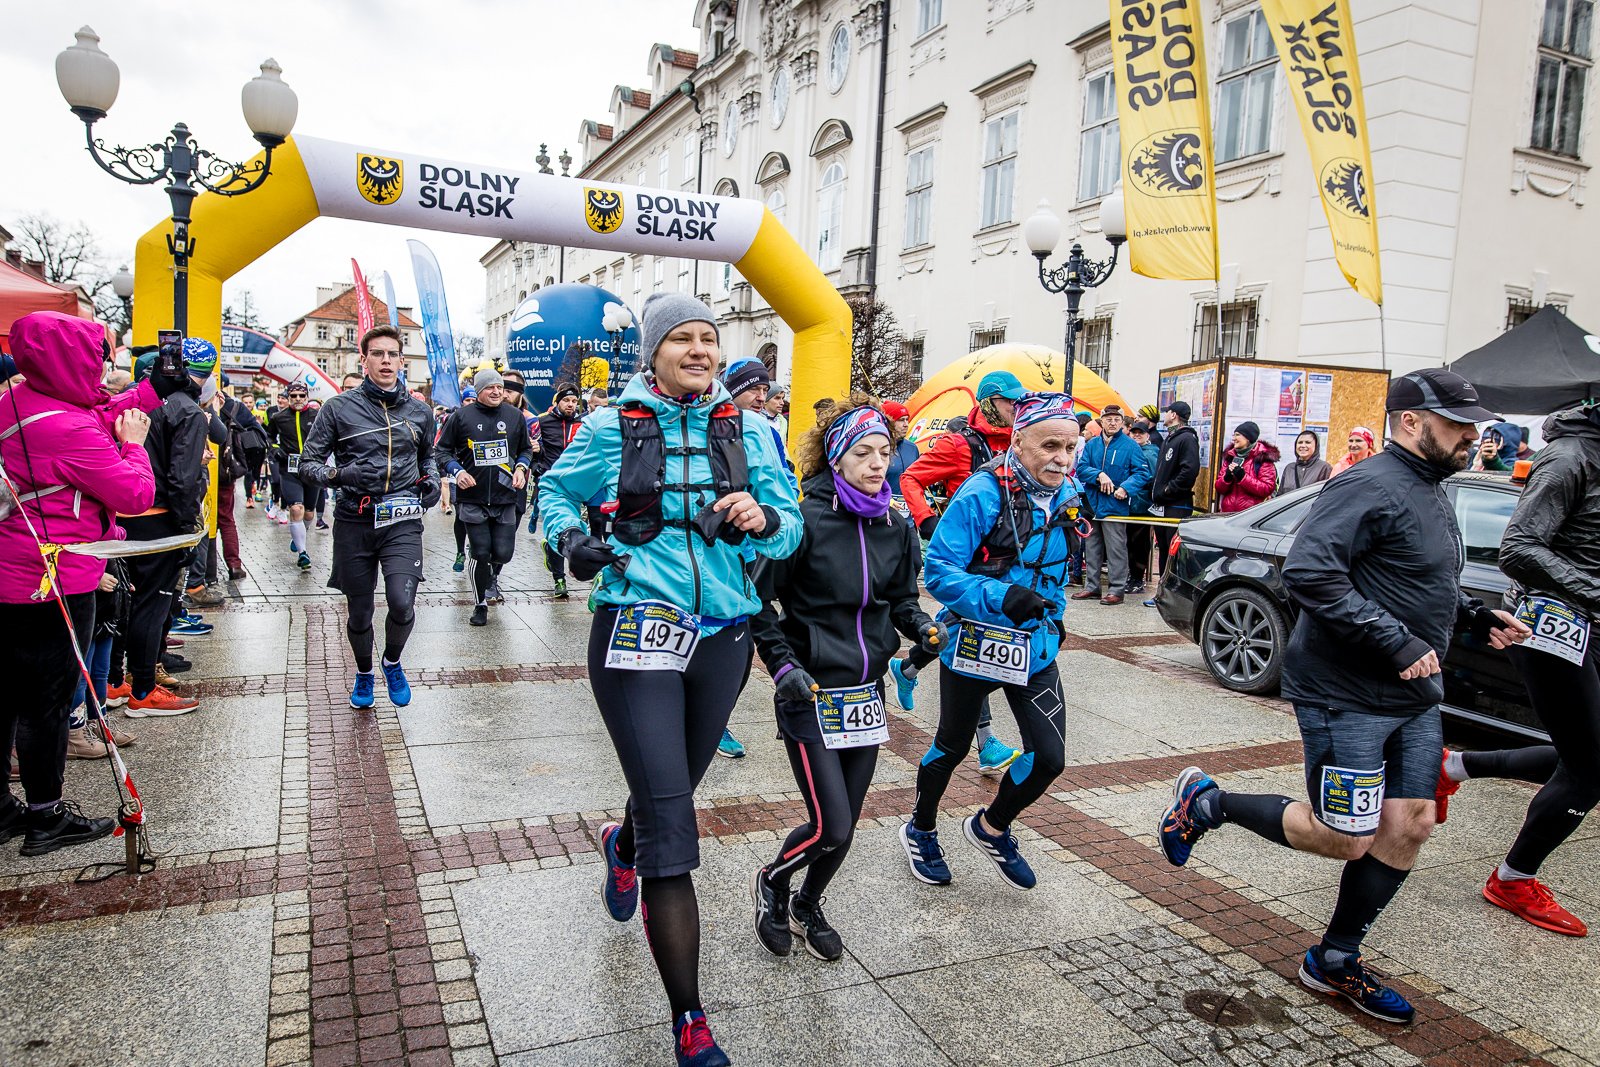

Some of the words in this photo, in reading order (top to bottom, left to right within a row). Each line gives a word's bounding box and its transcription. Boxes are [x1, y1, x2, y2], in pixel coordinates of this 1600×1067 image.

[420, 163, 520, 194] DOLNY
[418, 181, 515, 219] ŚLĄSK
[636, 193, 720, 219] DOLNY
[635, 210, 717, 242] ŚLĄSK
[507, 335, 565, 354] erferie.pl
[927, 418, 950, 431] JELE
[490, 447, 503, 458] 38
[620, 622, 637, 630] BIEG
[644, 622, 687, 652] 491
[1541, 616, 1582, 647] 524
[982, 643, 1023, 667] 490
[846, 702, 882, 728] 489
[1329, 789, 1348, 797] BIEG
